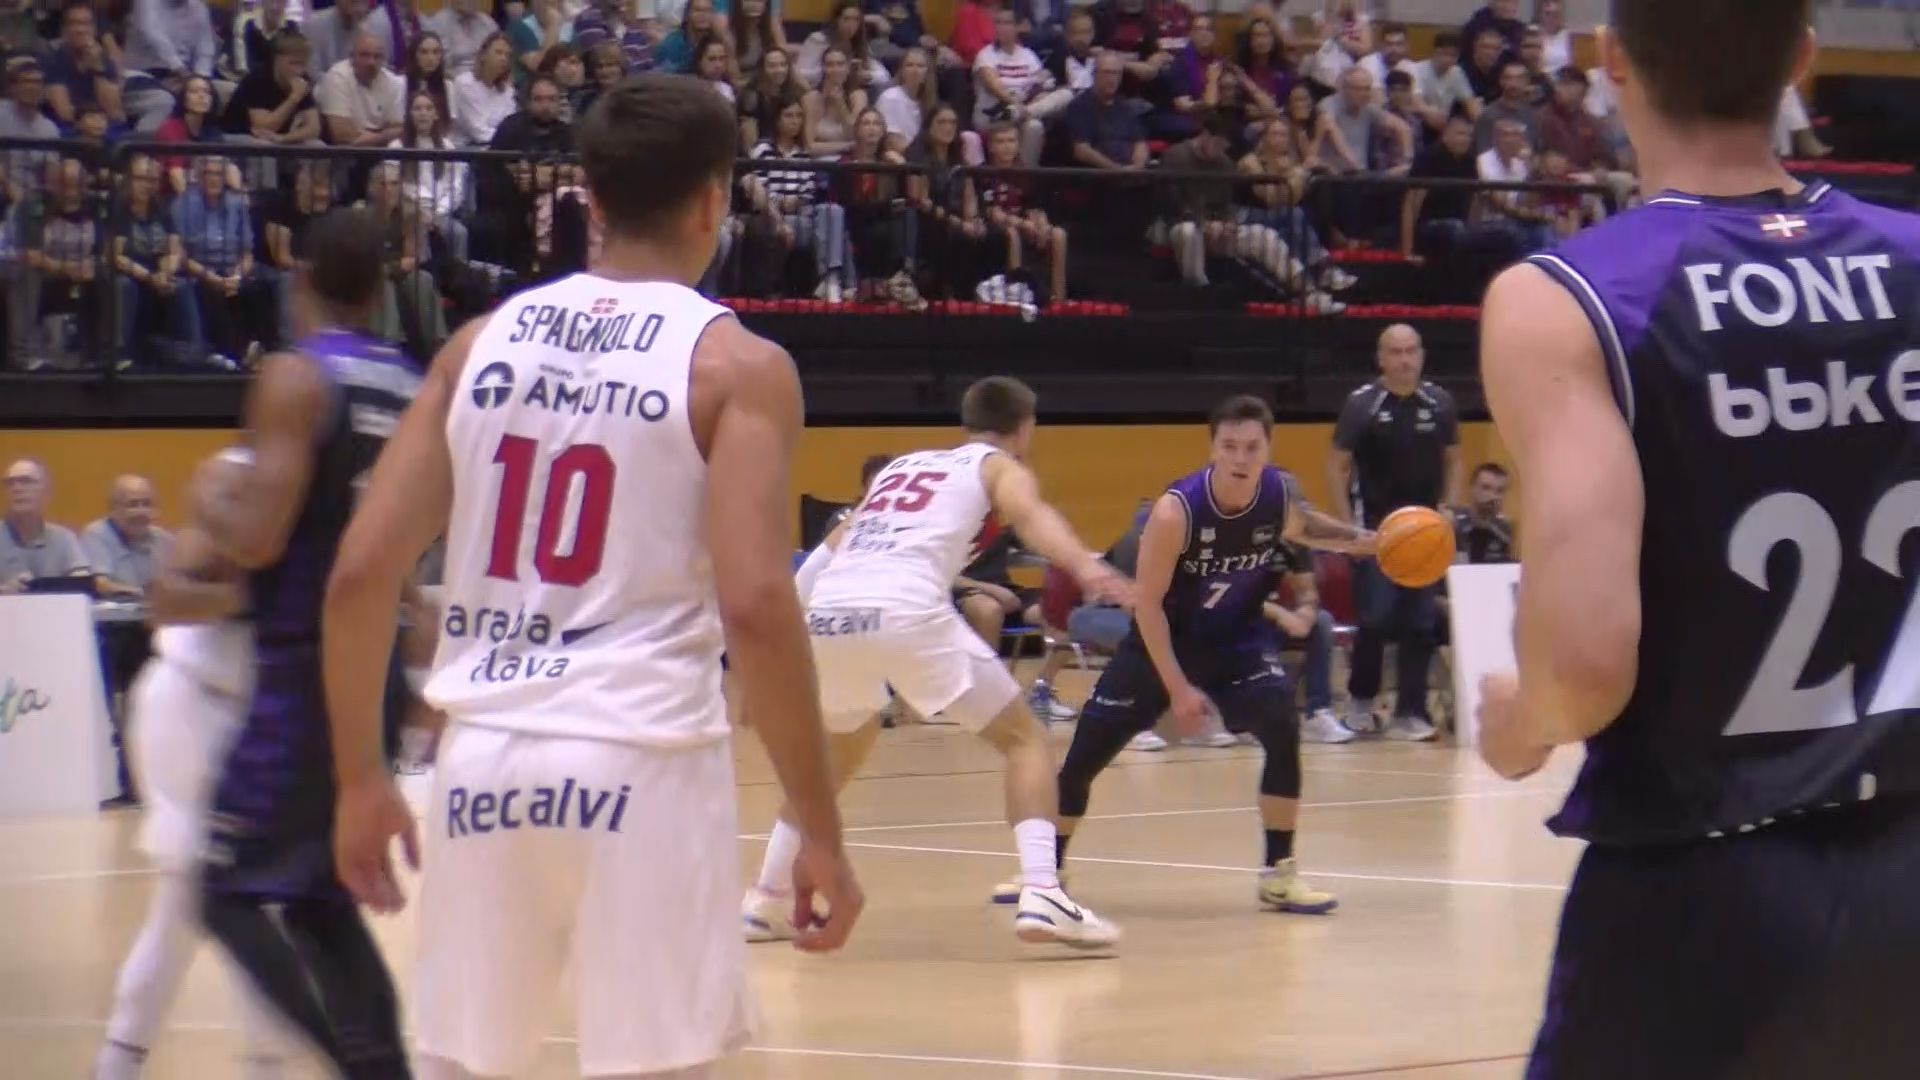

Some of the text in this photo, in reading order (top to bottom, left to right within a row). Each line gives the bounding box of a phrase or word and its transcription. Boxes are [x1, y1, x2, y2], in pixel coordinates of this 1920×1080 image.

[1684, 254, 1897, 332] FONT
[509, 304, 665, 353] SPAGNOLO
[523, 375, 671, 423] AMUTIO
[485, 433, 617, 588] 10
[861, 471, 949, 513] 25
[1203, 581, 1232, 610] 7
[446, 778, 632, 838] Recalvi
